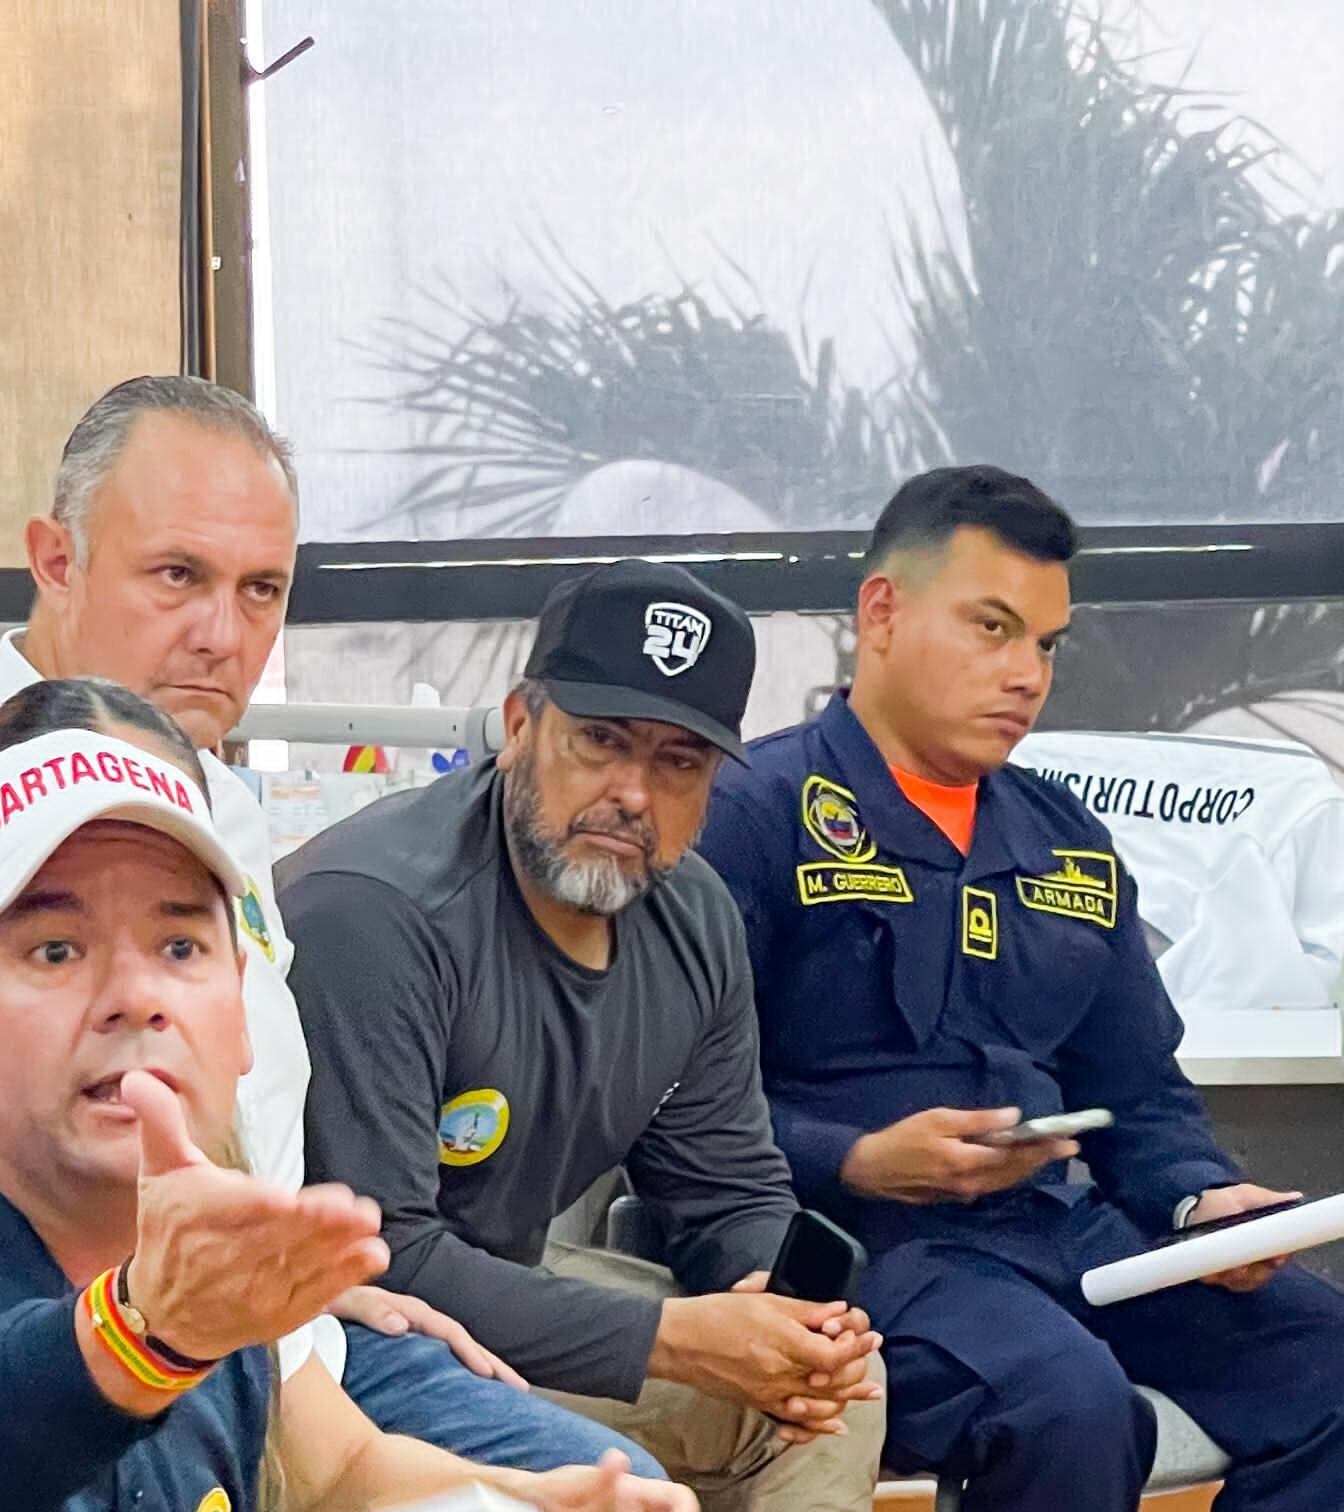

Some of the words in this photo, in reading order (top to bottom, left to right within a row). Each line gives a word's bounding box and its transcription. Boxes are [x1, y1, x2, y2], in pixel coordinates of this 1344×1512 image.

[654, 610, 704, 638] TITAN
[806, 873, 828, 894] M.
[1032, 885, 1105, 918] ARMADA
